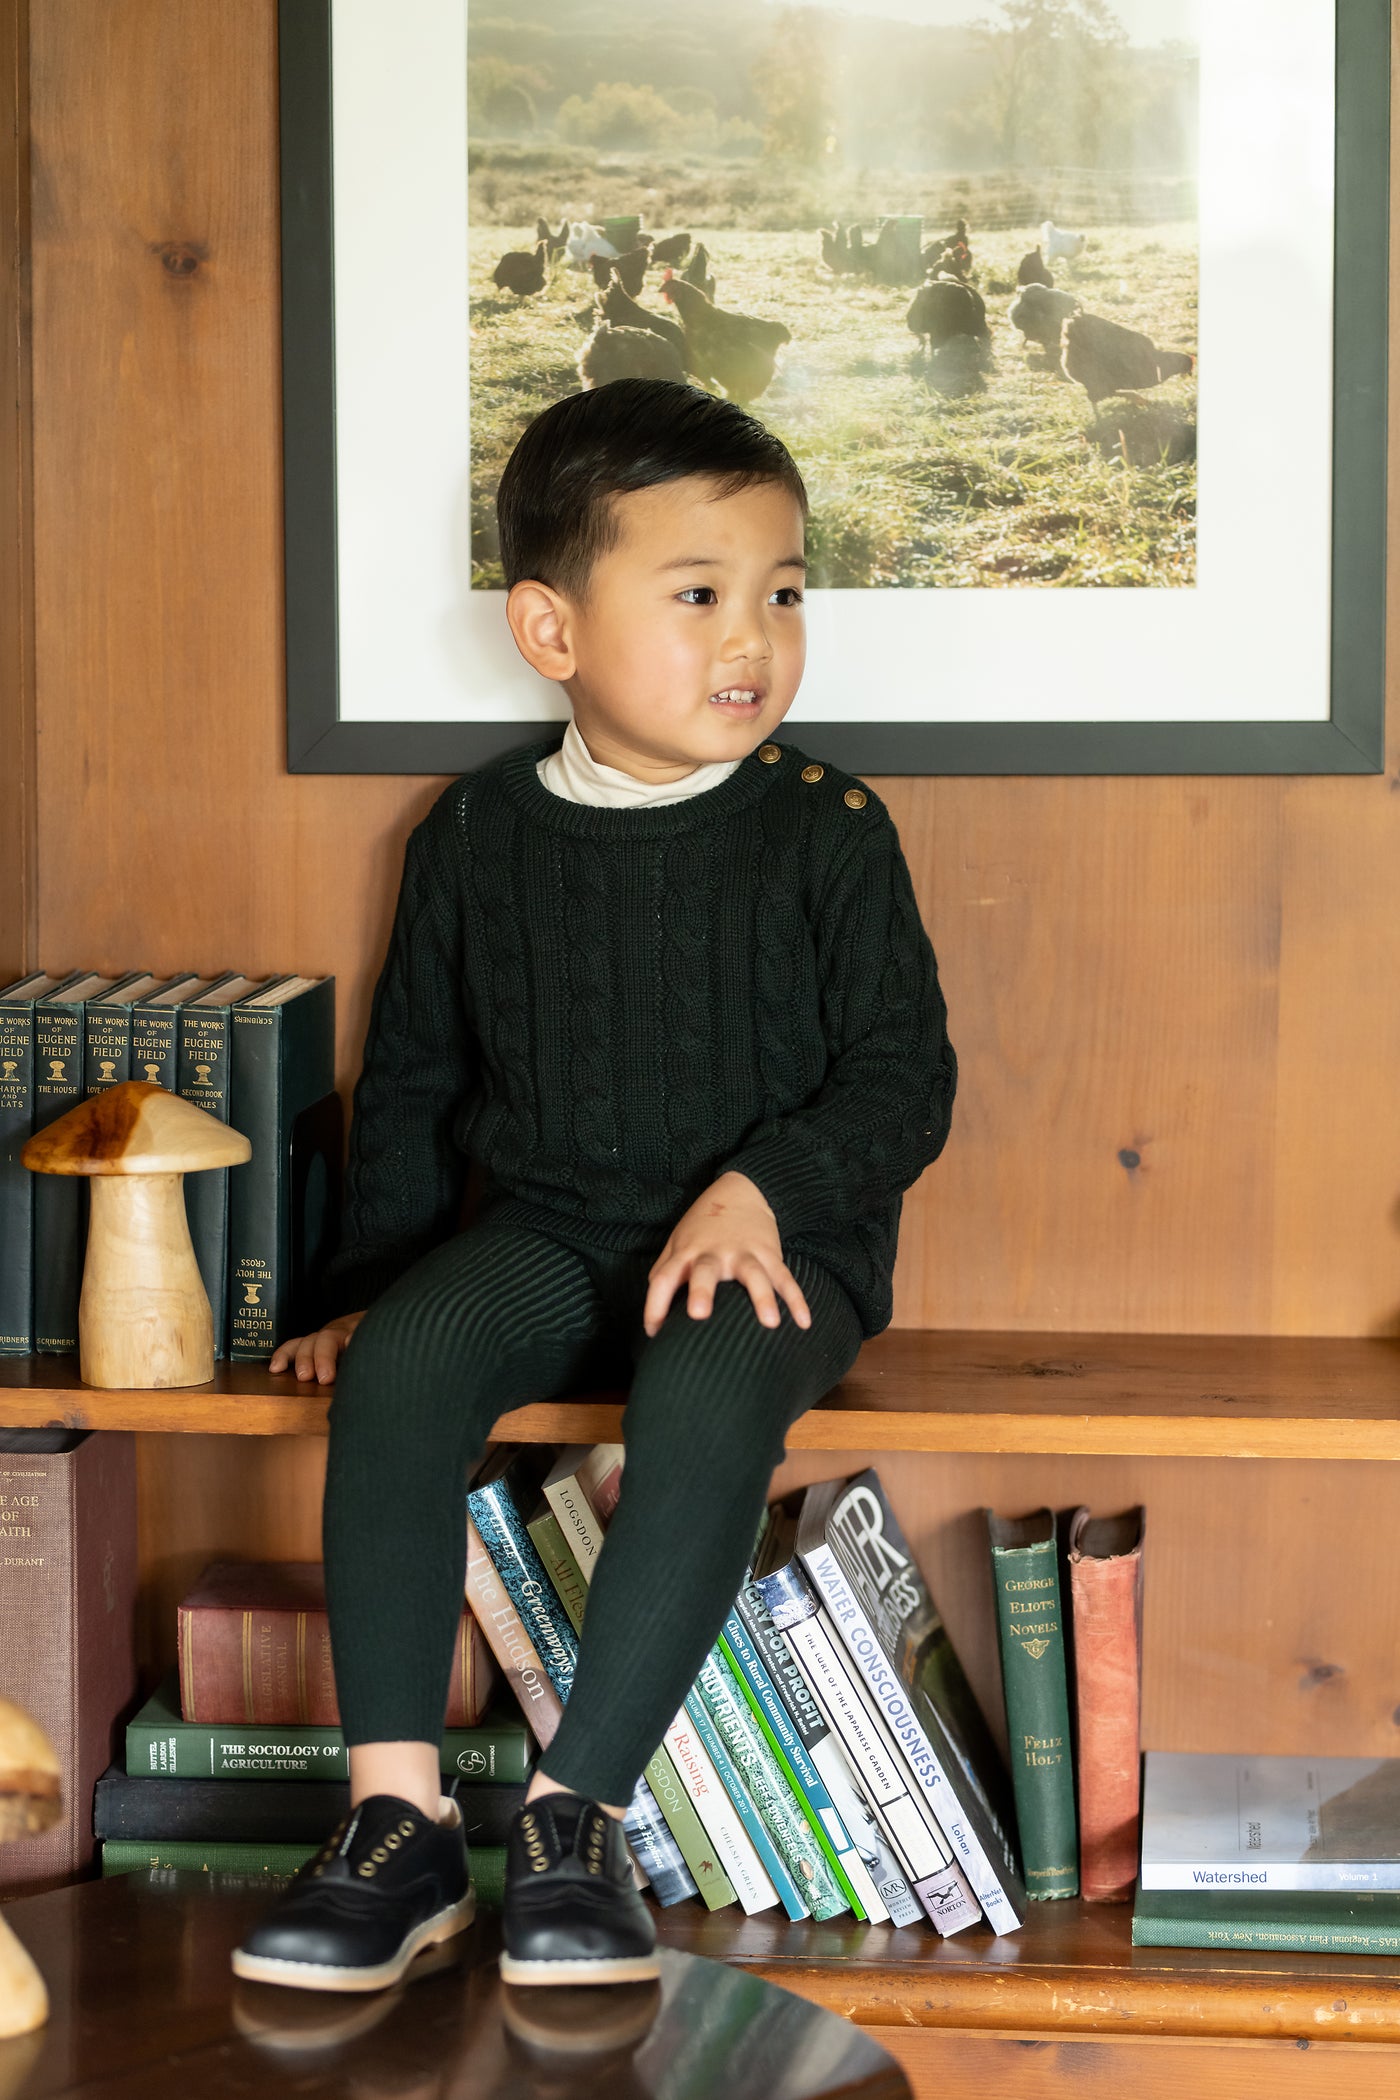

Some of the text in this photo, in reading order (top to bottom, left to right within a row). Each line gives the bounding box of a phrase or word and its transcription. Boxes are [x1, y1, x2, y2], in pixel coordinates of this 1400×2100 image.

[6, 1017, 31, 1027] WORKS
[37, 1016, 79, 1027] THE WORKS
[88, 1016, 129, 1027] THE WORKS
[133, 1019, 174, 1030] THE WORKS
[183, 1019, 225, 1031] THE WORKS
[37, 1034, 77, 1045] EUGENE
[88, 1034, 128, 1046] EUGENE
[133, 1037, 172, 1049] EUGENE
[183, 1037, 224, 1049] EUGENE
[42, 1046, 71, 1057] FIELD
[93, 1047, 122, 1057] FIELD
[137, 1049, 167, 1060] FIELD
[188, 1050, 218, 1061] FIELD
[37, 1085, 77, 1095] THE HOUSE
[87, 1086, 101, 1094] LOVE
[181, 1088, 223, 1099] SECOND BOOK
[196, 1101, 217, 1109] TALES
[241, 1258, 266, 1268] CROSS
[235, 1269, 272, 1279] THE HOLY
[239, 1307, 267, 1318] FIELD
[233, 1319, 273, 1330] EUGENE
[232, 1337, 274, 1348] THE WORKS
[11, 1496, 40, 1507] AGE
[2, 1510, 19, 1521] OF
[560, 1490, 597, 1557] LOGSDON
[4, 1558, 45, 1567] DURANT
[551, 1558, 574, 1582] All
[1005, 1577, 1055, 1592] GEORGE
[1009, 1600, 1056, 1614] ELIOT'S
[467, 1547, 546, 1702] The Hudson
[521, 1579, 574, 1673] Greenways
[1010, 1622, 1058, 1636] NOVELS
[748, 1619, 757, 1633] John
[755, 1632, 768, 1654] Bellamy
[766, 1654, 777, 1674] Foster,
[775, 1674, 784, 1685] and
[780, 1684, 797, 1712] Frederick
[763, 1625, 791, 1666] FOR
[783, 1663, 825, 1729] PROFIT
[815, 1556, 857, 1624] WATER
[850, 1626, 942, 1789] CONSCIOUSNESS
[727, 1619, 819, 1788] Clues to Rural Community Survival
[700, 1667, 758, 1767] NUTRIENTS
[804, 1633, 891, 1790] THE LURE OF THE JAPANESE GARDEN
[221, 1745, 340, 1757] THE SOCIOLOGY OF
[221, 1759, 308, 1770] AGRICULTURE
[1025, 1752, 1062, 1766] HOLT
[674, 1732, 710, 1799] Raising
[699, 1719, 707, 1727] 17
[705, 1733, 722, 1760] NUMBER
[724, 1771, 742, 1800] OCTOBER
[738, 1799, 750, 1815] 2012
[753, 1772, 801, 1863] JEFF LOWENFELS
[628, 1806, 665, 1870] Johns Hopkins
[951, 1823, 970, 1856] Lohan
[720, 1826, 757, 1899] CHELSEA GREEN
[1192, 1871, 1267, 1883] Watershed
[1339, 1873, 1378, 1881] Volume 1
[979, 1887, 1003, 1902] AlterNet
[888, 1896, 911, 1908] MONTHLY
[985, 1897, 1003, 1909] Books
[893, 1903, 912, 1914] REVIEW
[899, 1909, 915, 1919] PRESS
[936, 1900, 967, 1917] NORTON
[1208, 1930, 1230, 1941] York
[1232, 1931, 1252, 1941] New
[1255, 1932, 1306, 1944] Association,
[1309, 1934, 1329, 1944] Plan
